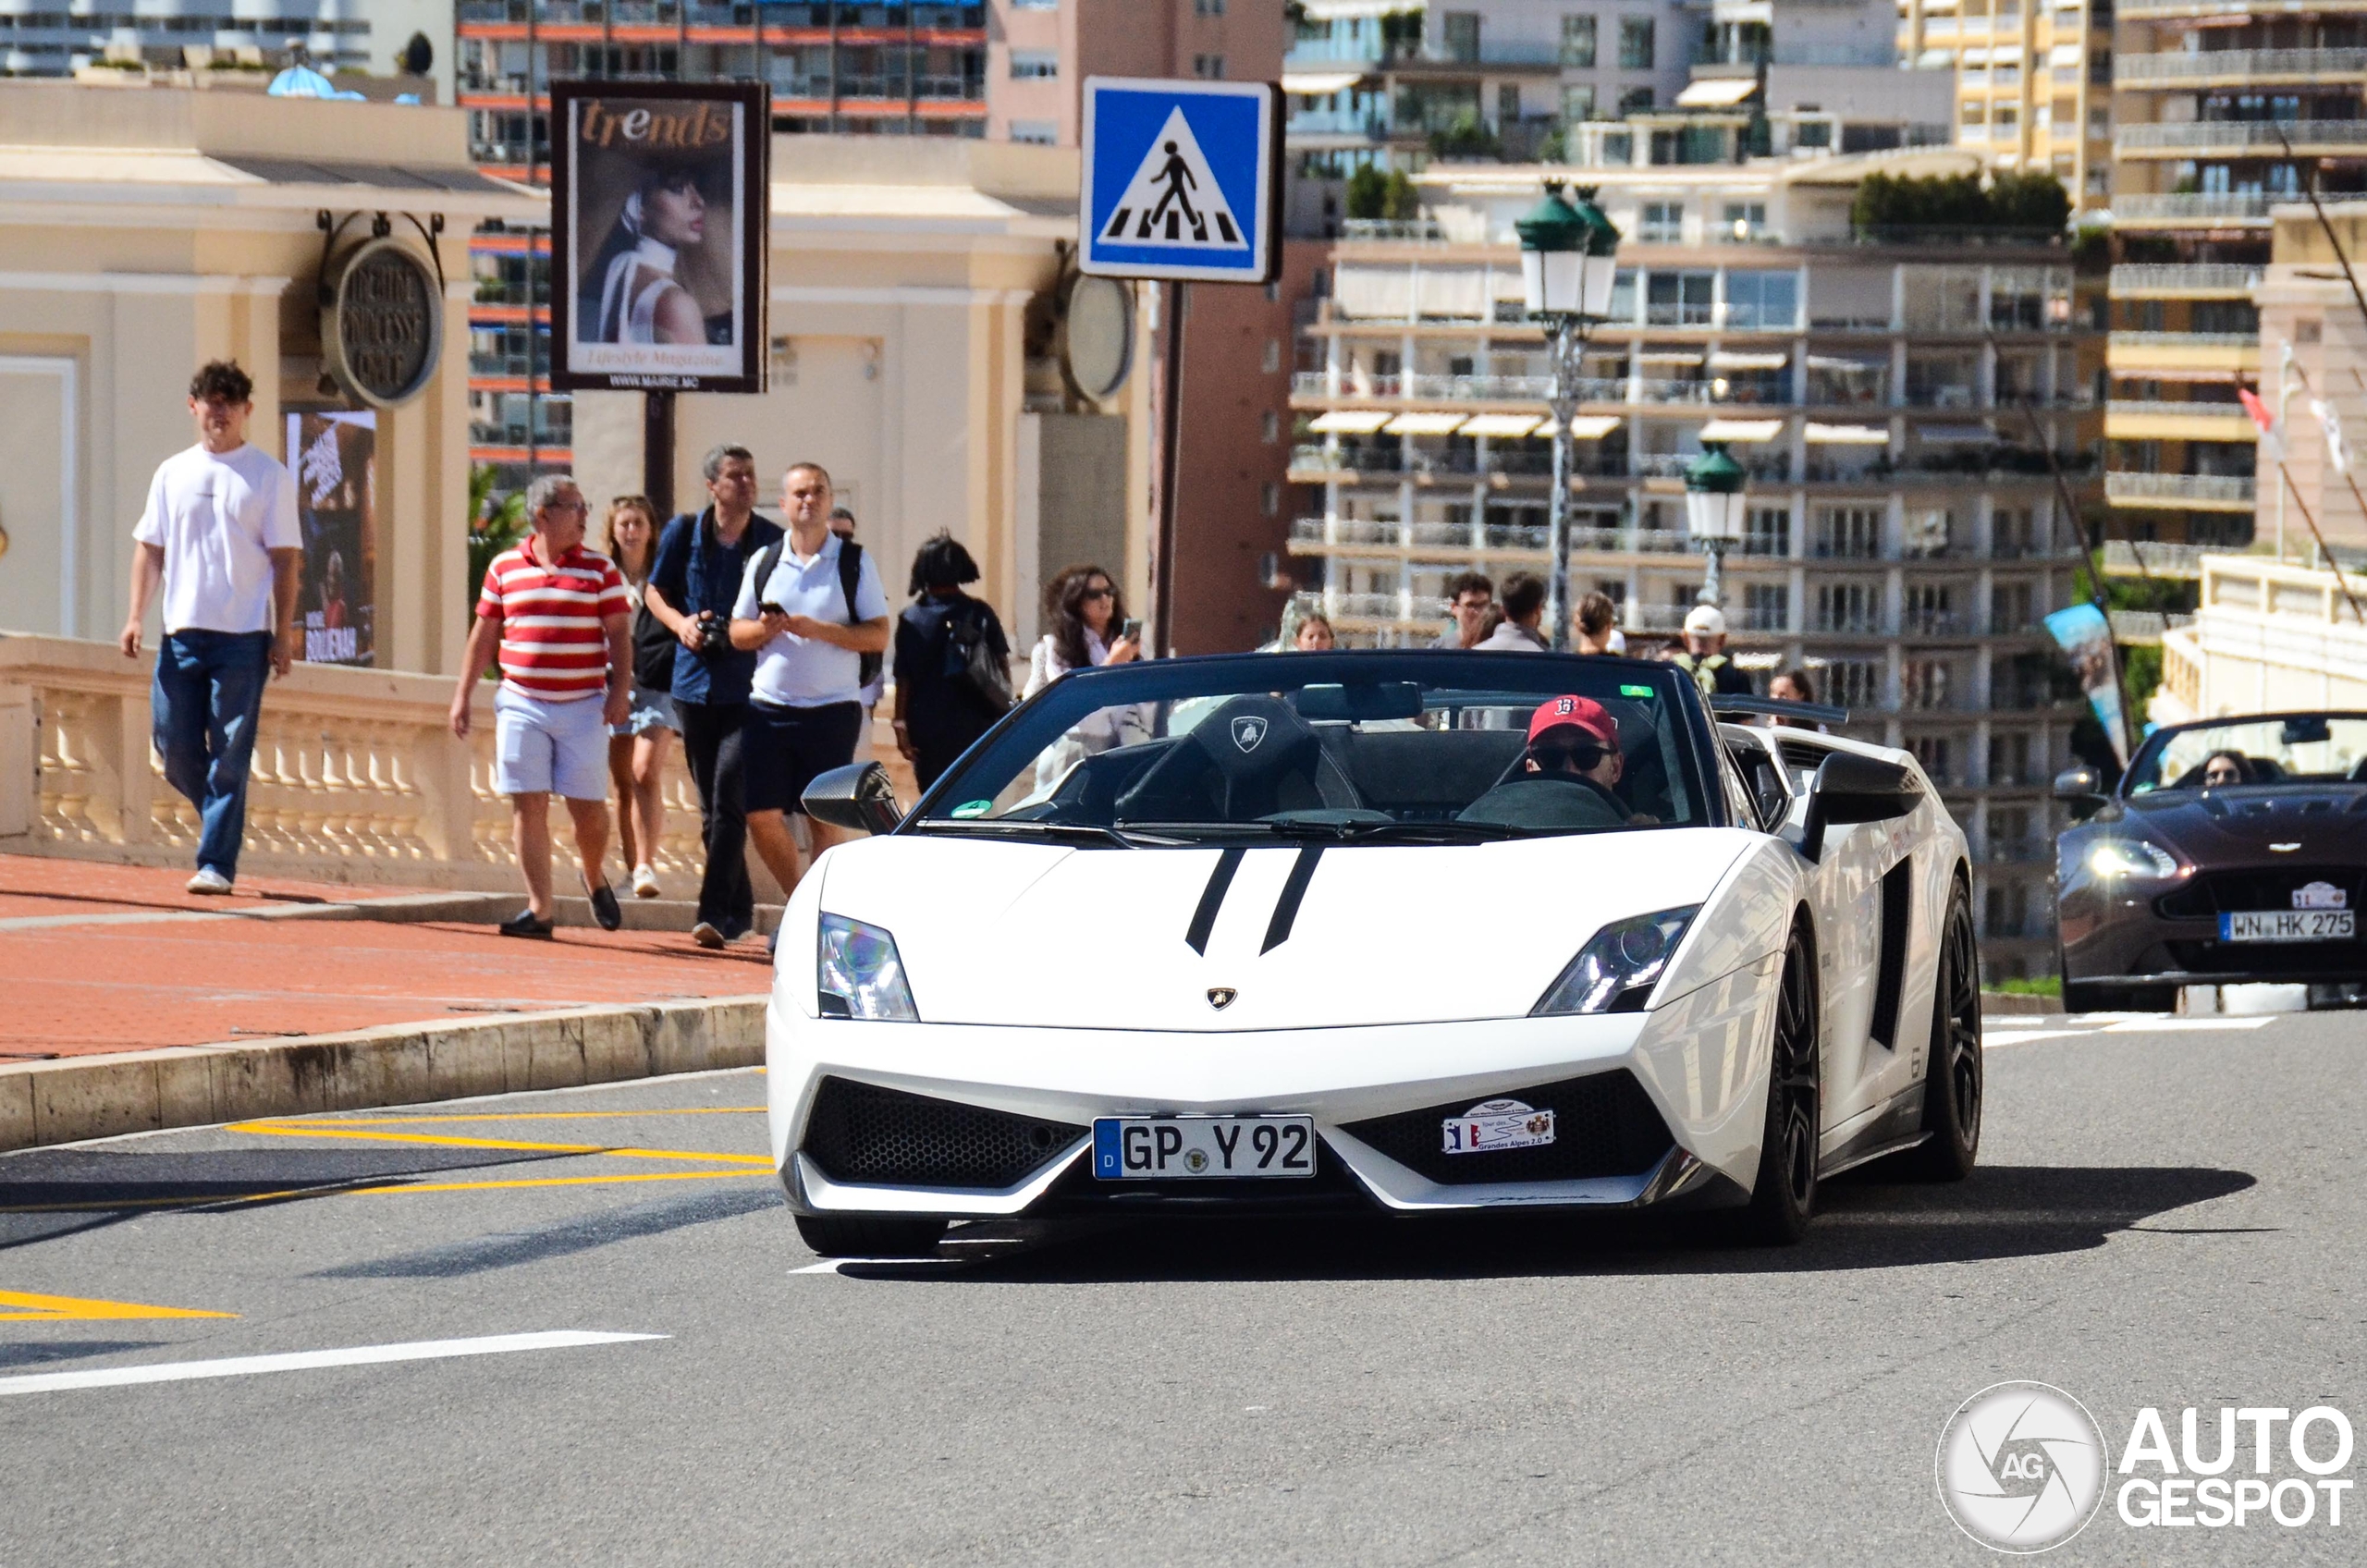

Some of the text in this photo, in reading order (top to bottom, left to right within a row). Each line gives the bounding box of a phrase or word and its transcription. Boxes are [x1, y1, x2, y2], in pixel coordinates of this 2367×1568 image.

[582, 99, 729, 147] trends
[588, 349, 647, 365] Lifestyle
[2233, 913, 2263, 936] WN
[2276, 913, 2306, 936] HK
[2312, 913, 2352, 935] 275
[1123, 1124, 1309, 1170] GP Y 92
[1478, 1142, 1509, 1150] Grandes
[1510, 1140, 1530, 1148] Alpes
[1104, 1155, 1114, 1168] D
